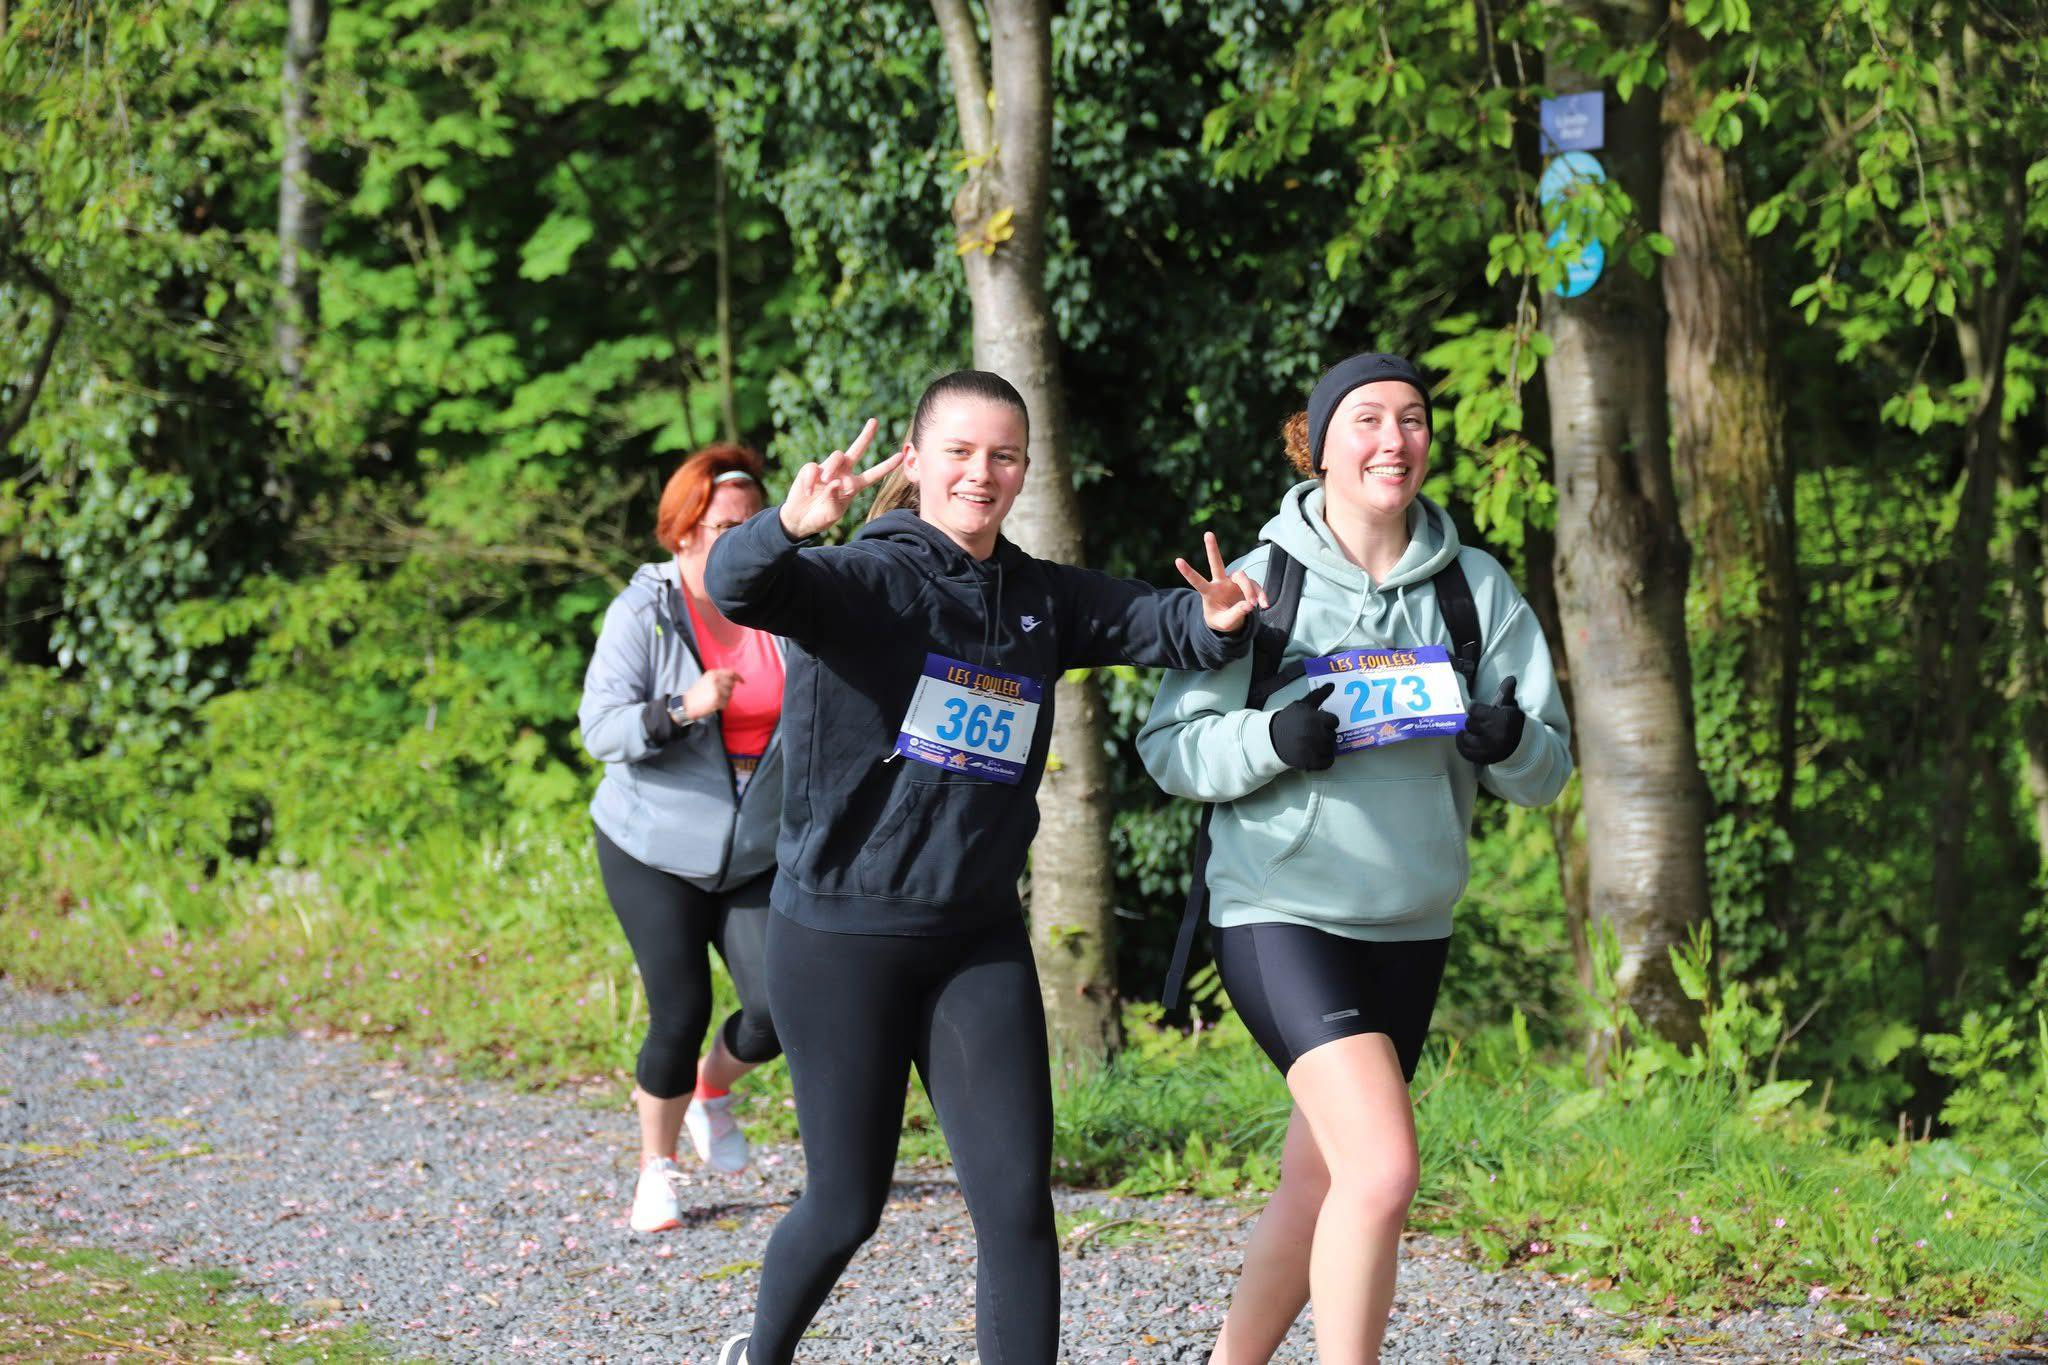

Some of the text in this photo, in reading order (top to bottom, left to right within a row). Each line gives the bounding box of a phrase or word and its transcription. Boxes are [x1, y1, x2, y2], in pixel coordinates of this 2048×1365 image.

[947, 666, 971, 685] LES
[1330, 658, 1353, 672] LES
[1358, 652, 1416, 669] FOULÉES
[1344, 675, 1432, 723] 273
[936, 697, 1015, 753] 365
